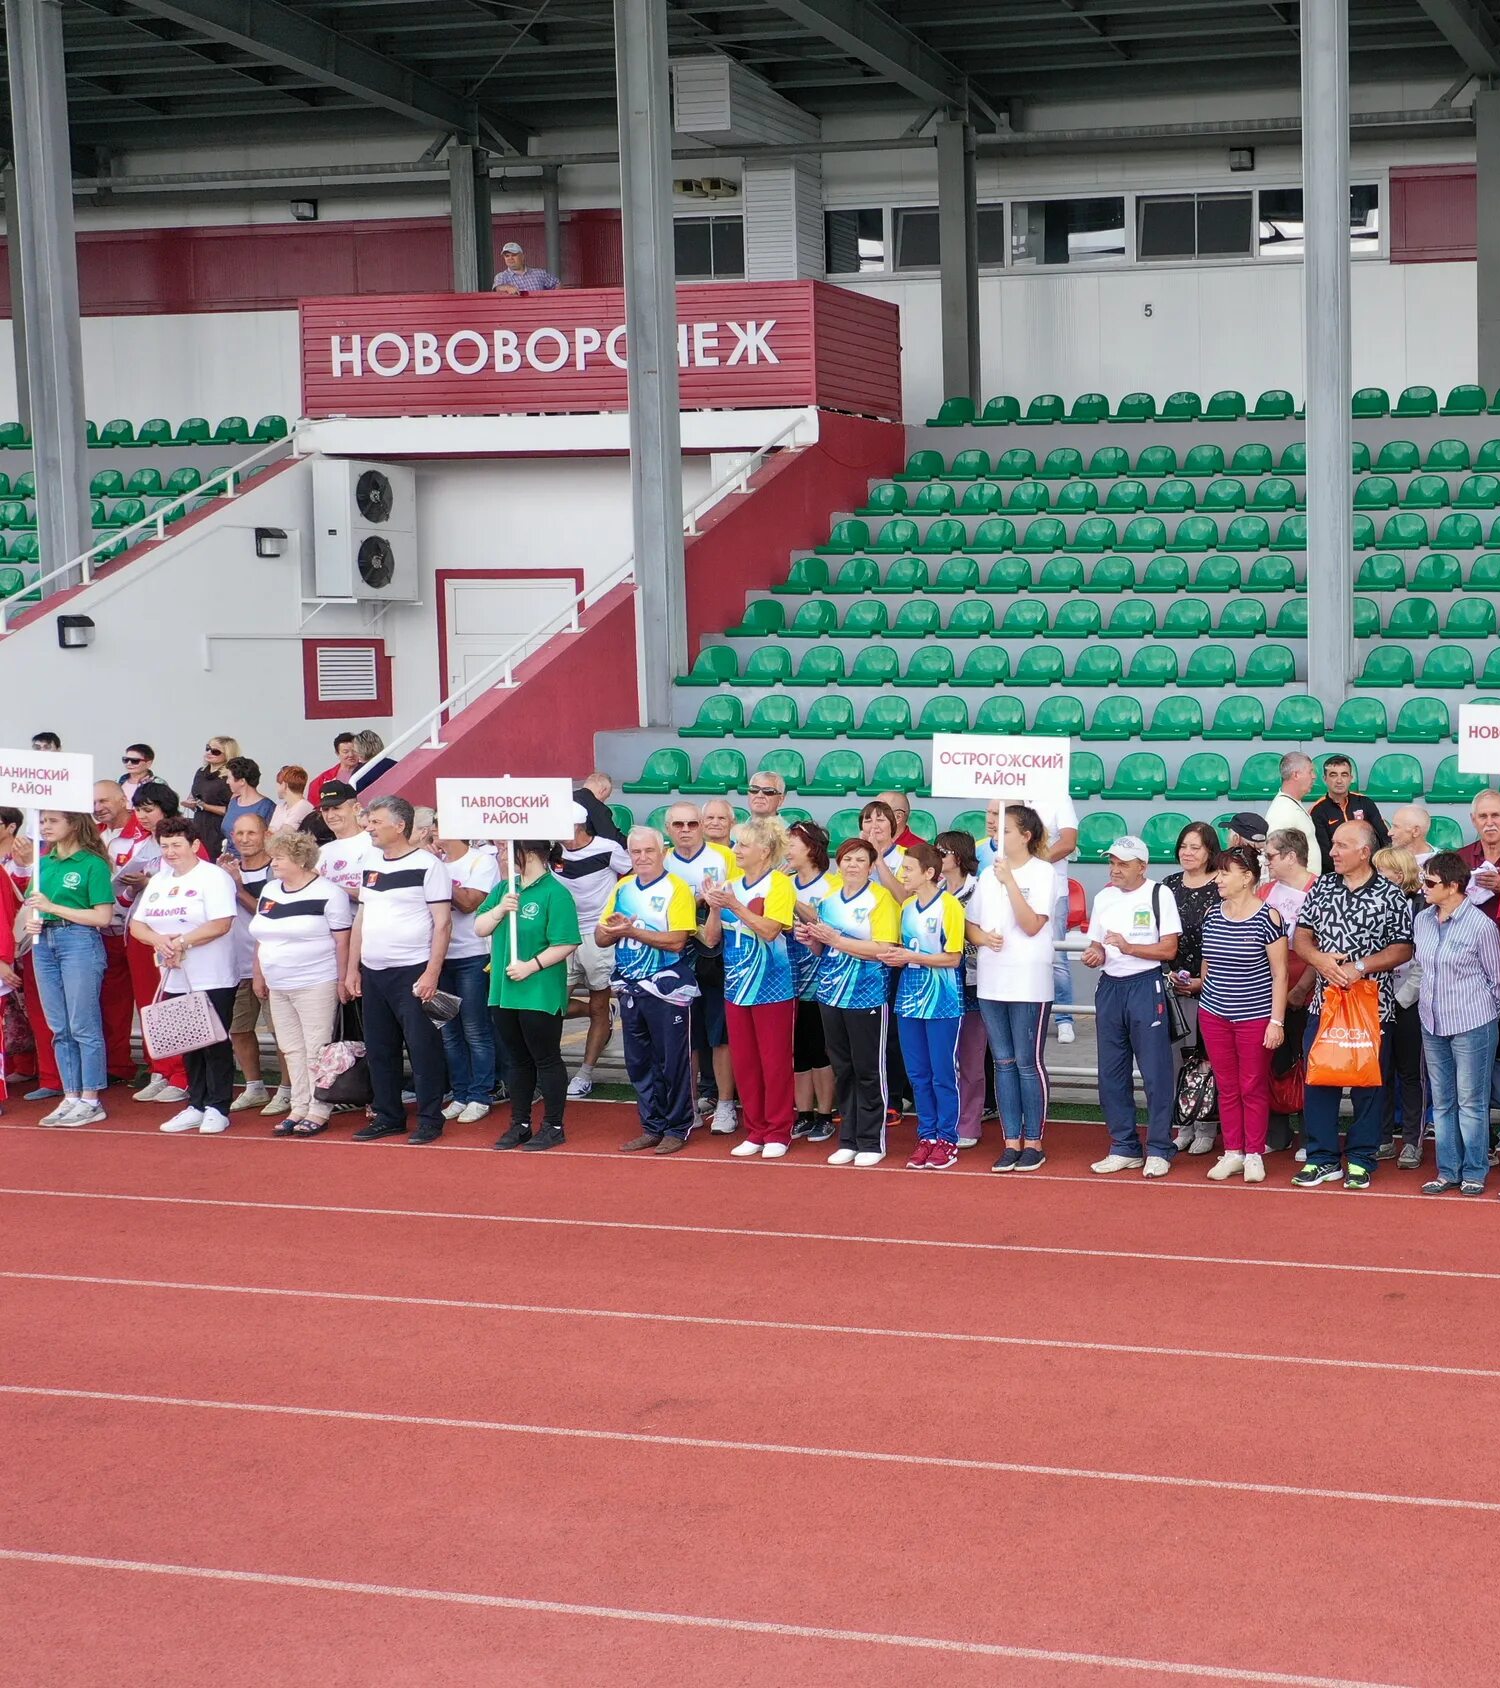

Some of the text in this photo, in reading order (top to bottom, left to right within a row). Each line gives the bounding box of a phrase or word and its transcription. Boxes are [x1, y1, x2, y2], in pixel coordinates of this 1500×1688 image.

[1144, 304, 1153, 317] 5
[940, 751, 1063, 769] ОСТРОГОЖСКИЙ
[0, 765, 69, 781] АНИНСКИЙ
[975, 770, 1026, 786] РАЙОН
[11, 781, 52, 796] РАЙОН
[461, 794, 549, 808] ПАВЛОВСКИЙ
[483, 810, 528, 824] РАЙОН
